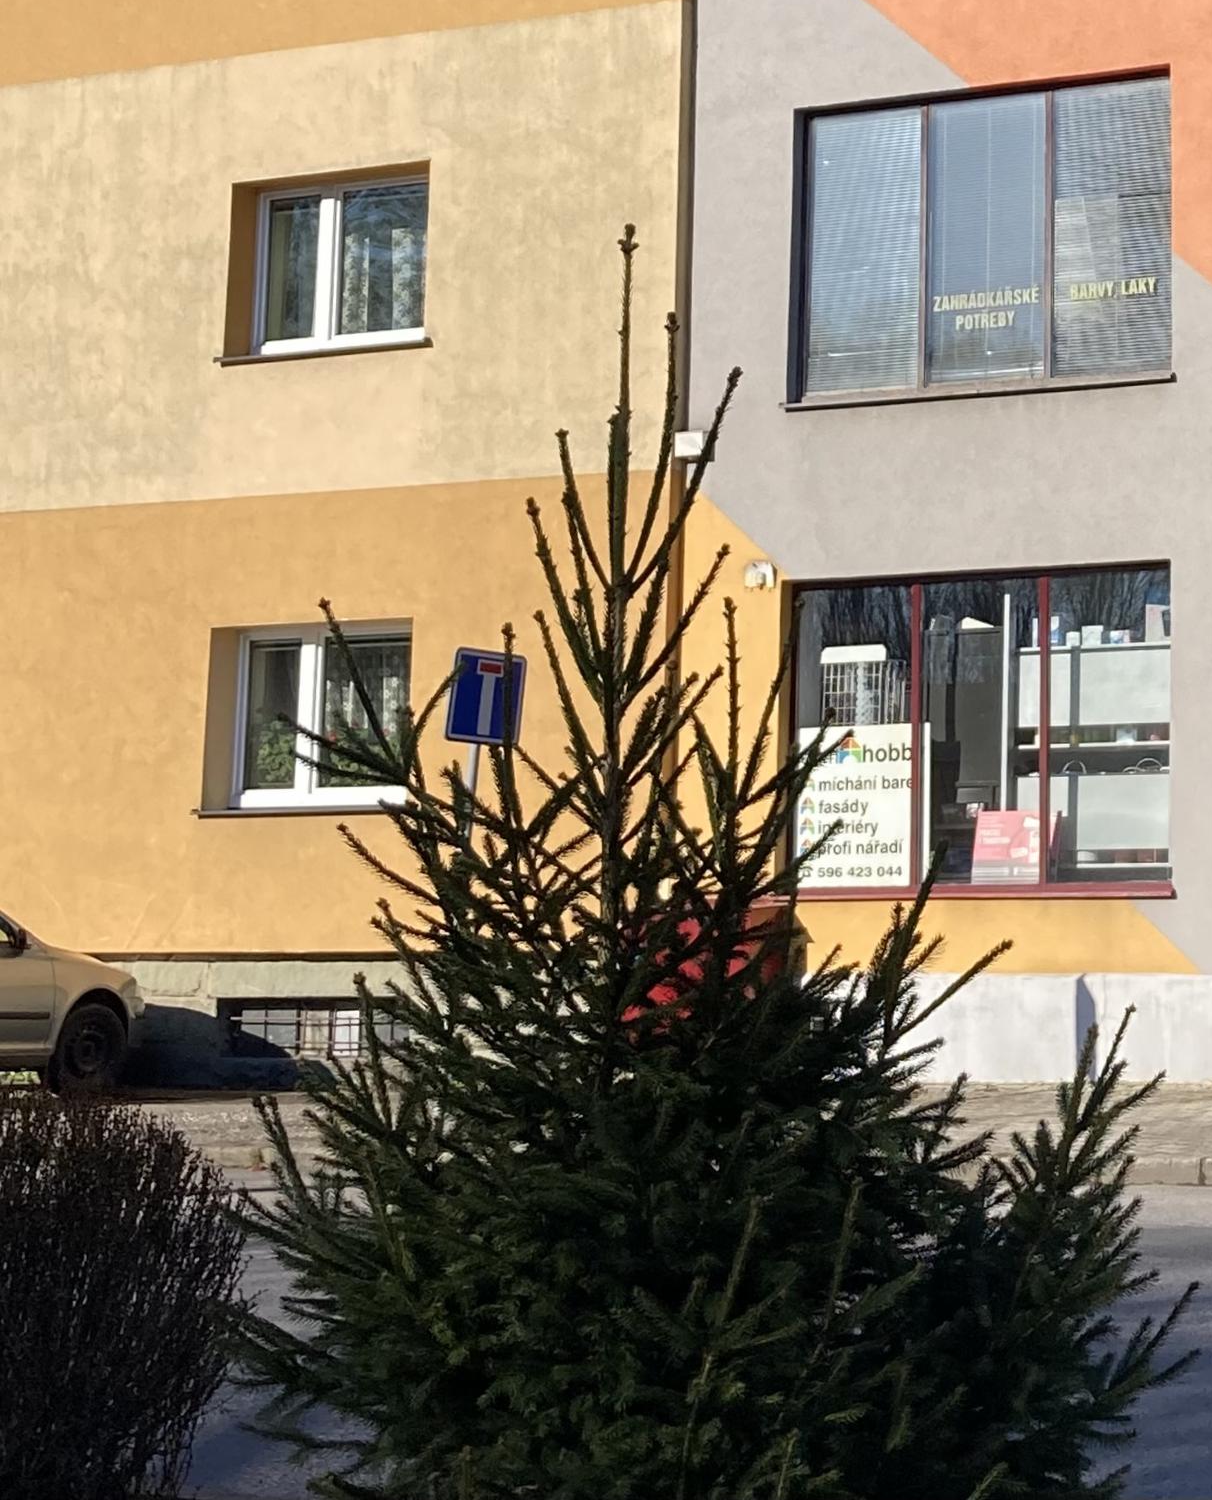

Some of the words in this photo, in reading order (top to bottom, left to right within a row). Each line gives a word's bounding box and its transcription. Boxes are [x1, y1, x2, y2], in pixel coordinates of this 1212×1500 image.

[1121, 277, 1156, 295] LAKY
[955, 309, 1015, 330] POTŘEBY
[863, 743, 912, 763] hobb
[818, 775, 878, 791] míchání
[882, 775, 912, 790] bare
[818, 799, 869, 817] fasády
[818, 819, 878, 837] ineriéry
[818, 840, 852, 858] profi
[856, 839, 904, 854] nářadí
[817, 867, 843, 878] 596
[847, 867, 872, 877] 423
[876, 866, 902, 877] 044
